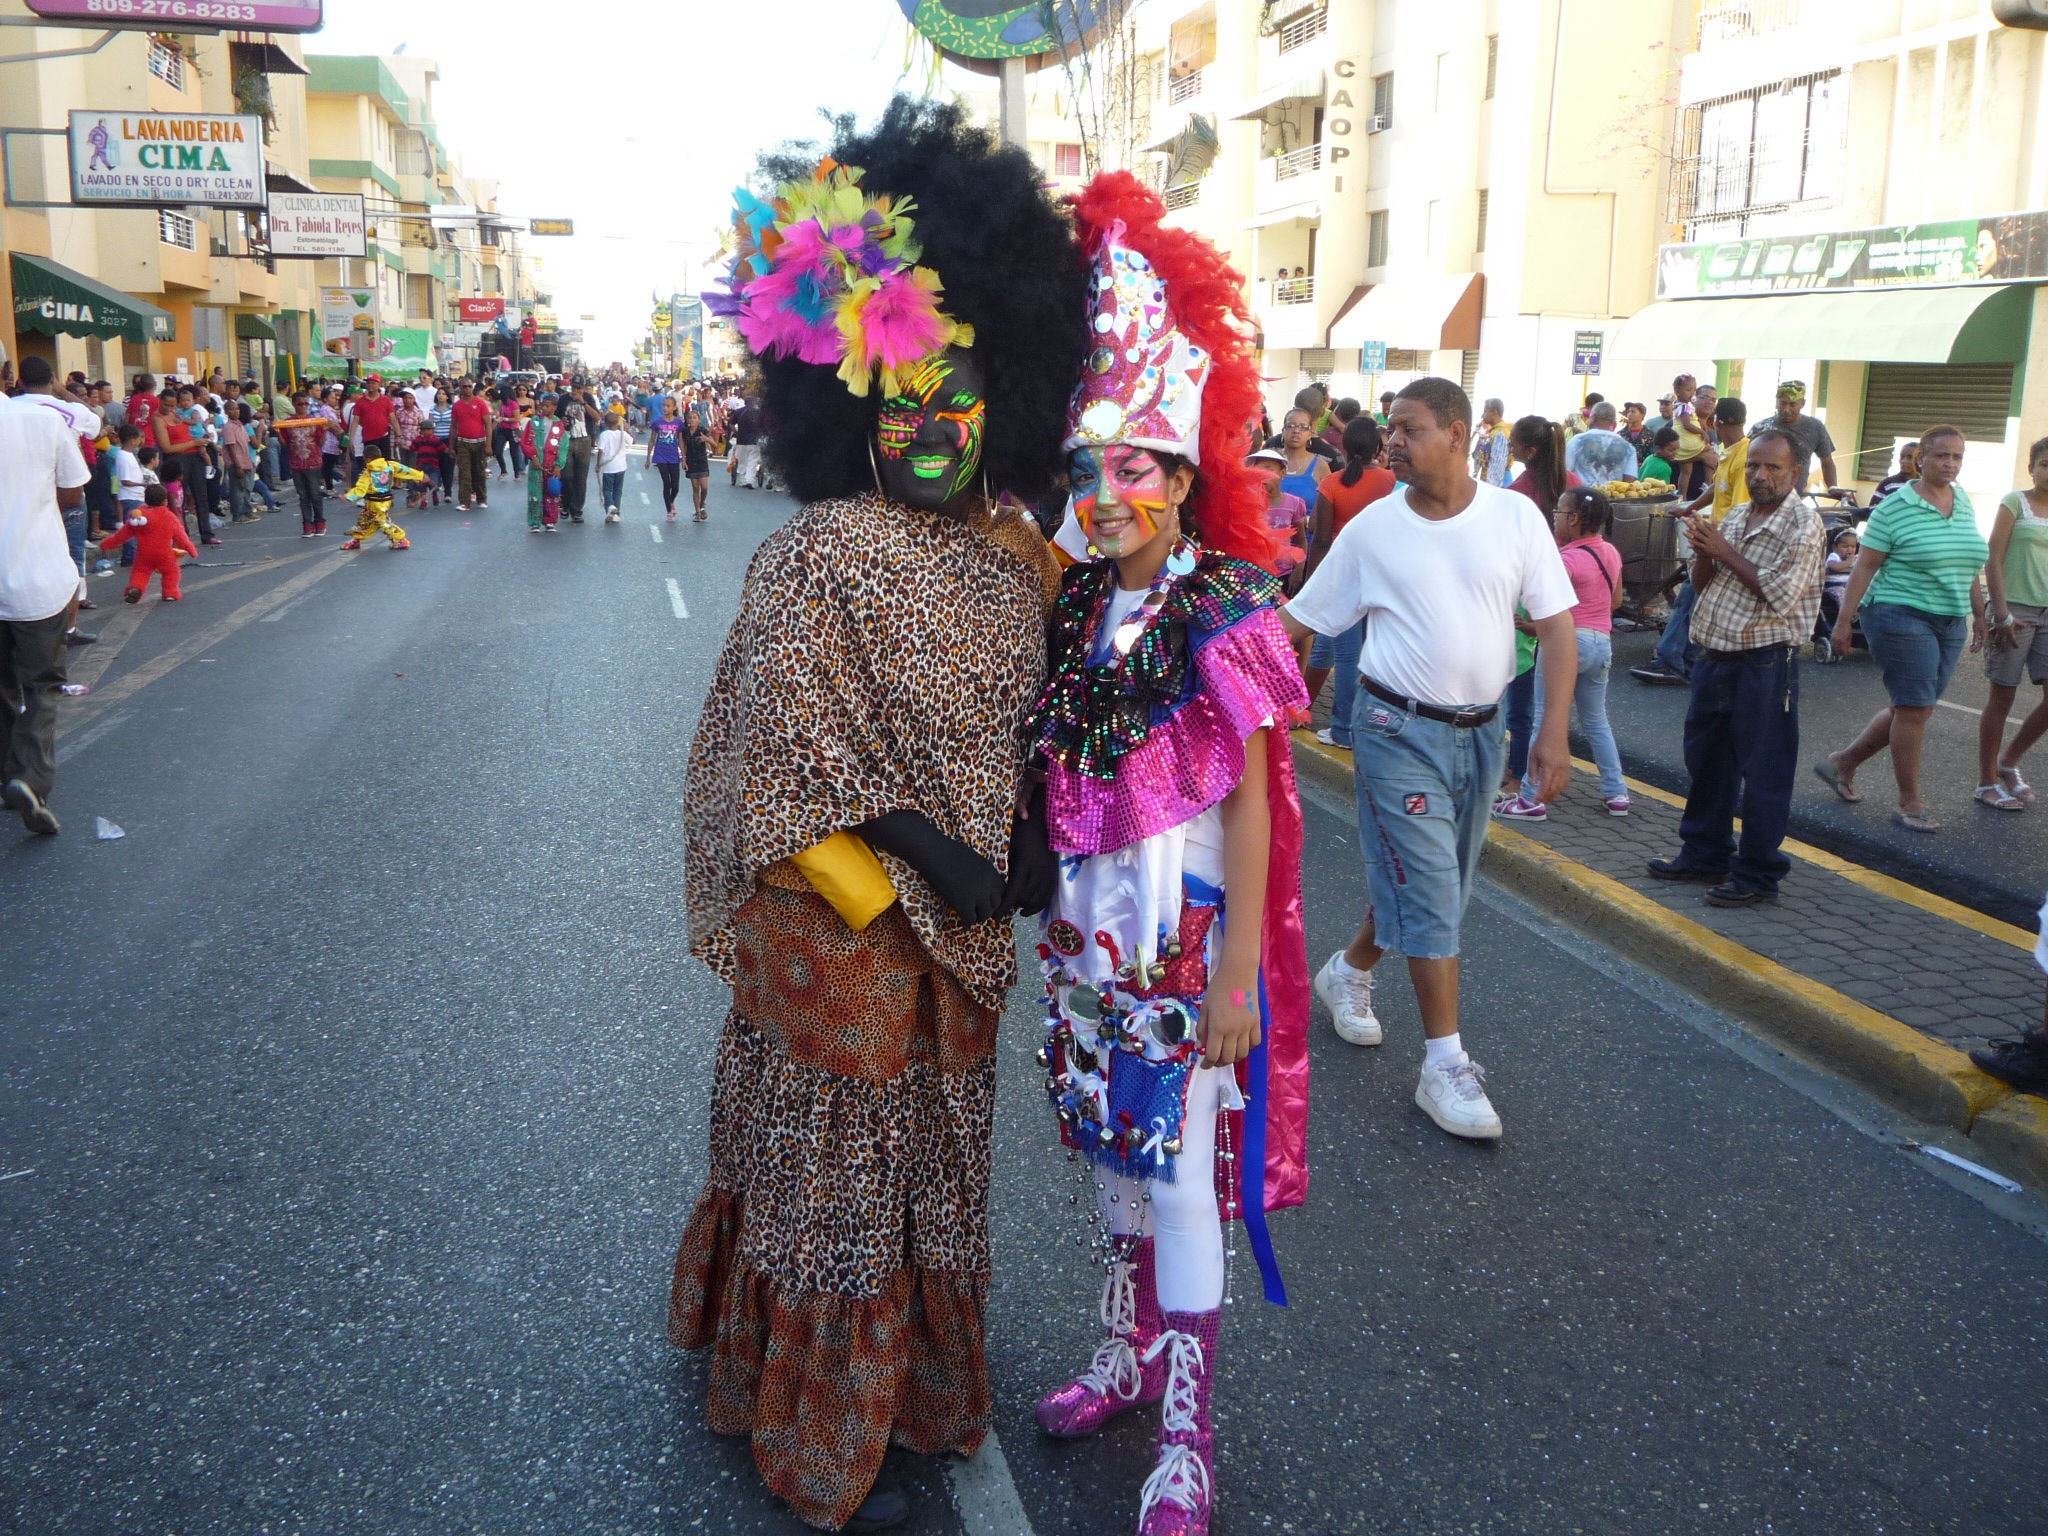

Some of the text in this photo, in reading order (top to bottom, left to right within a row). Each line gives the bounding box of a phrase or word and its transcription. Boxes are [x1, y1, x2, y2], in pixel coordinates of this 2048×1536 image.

[87, 0, 256, 20] 809-276-8283
[122, 118, 245, 143] LAVANDERIA
[1330, 60, 1356, 192] CAOPI
[138, 144, 231, 171] CIMA
[80, 174, 253, 189] LAVADO EN SECO O DRY CLEAN
[83, 188, 132, 198] SERVICIO
[136, 188, 149, 197] EN
[162, 189, 192, 198] HORA
[323, 199, 360, 212] DENTAL
[271, 215, 363, 237] Dra. Fabiola Reyes
[1706, 234, 1867, 280] Cindy
[40, 301, 94, 323] CIMA
[468, 304, 492, 312] Claro
[100, 316, 128, 327] 3027
